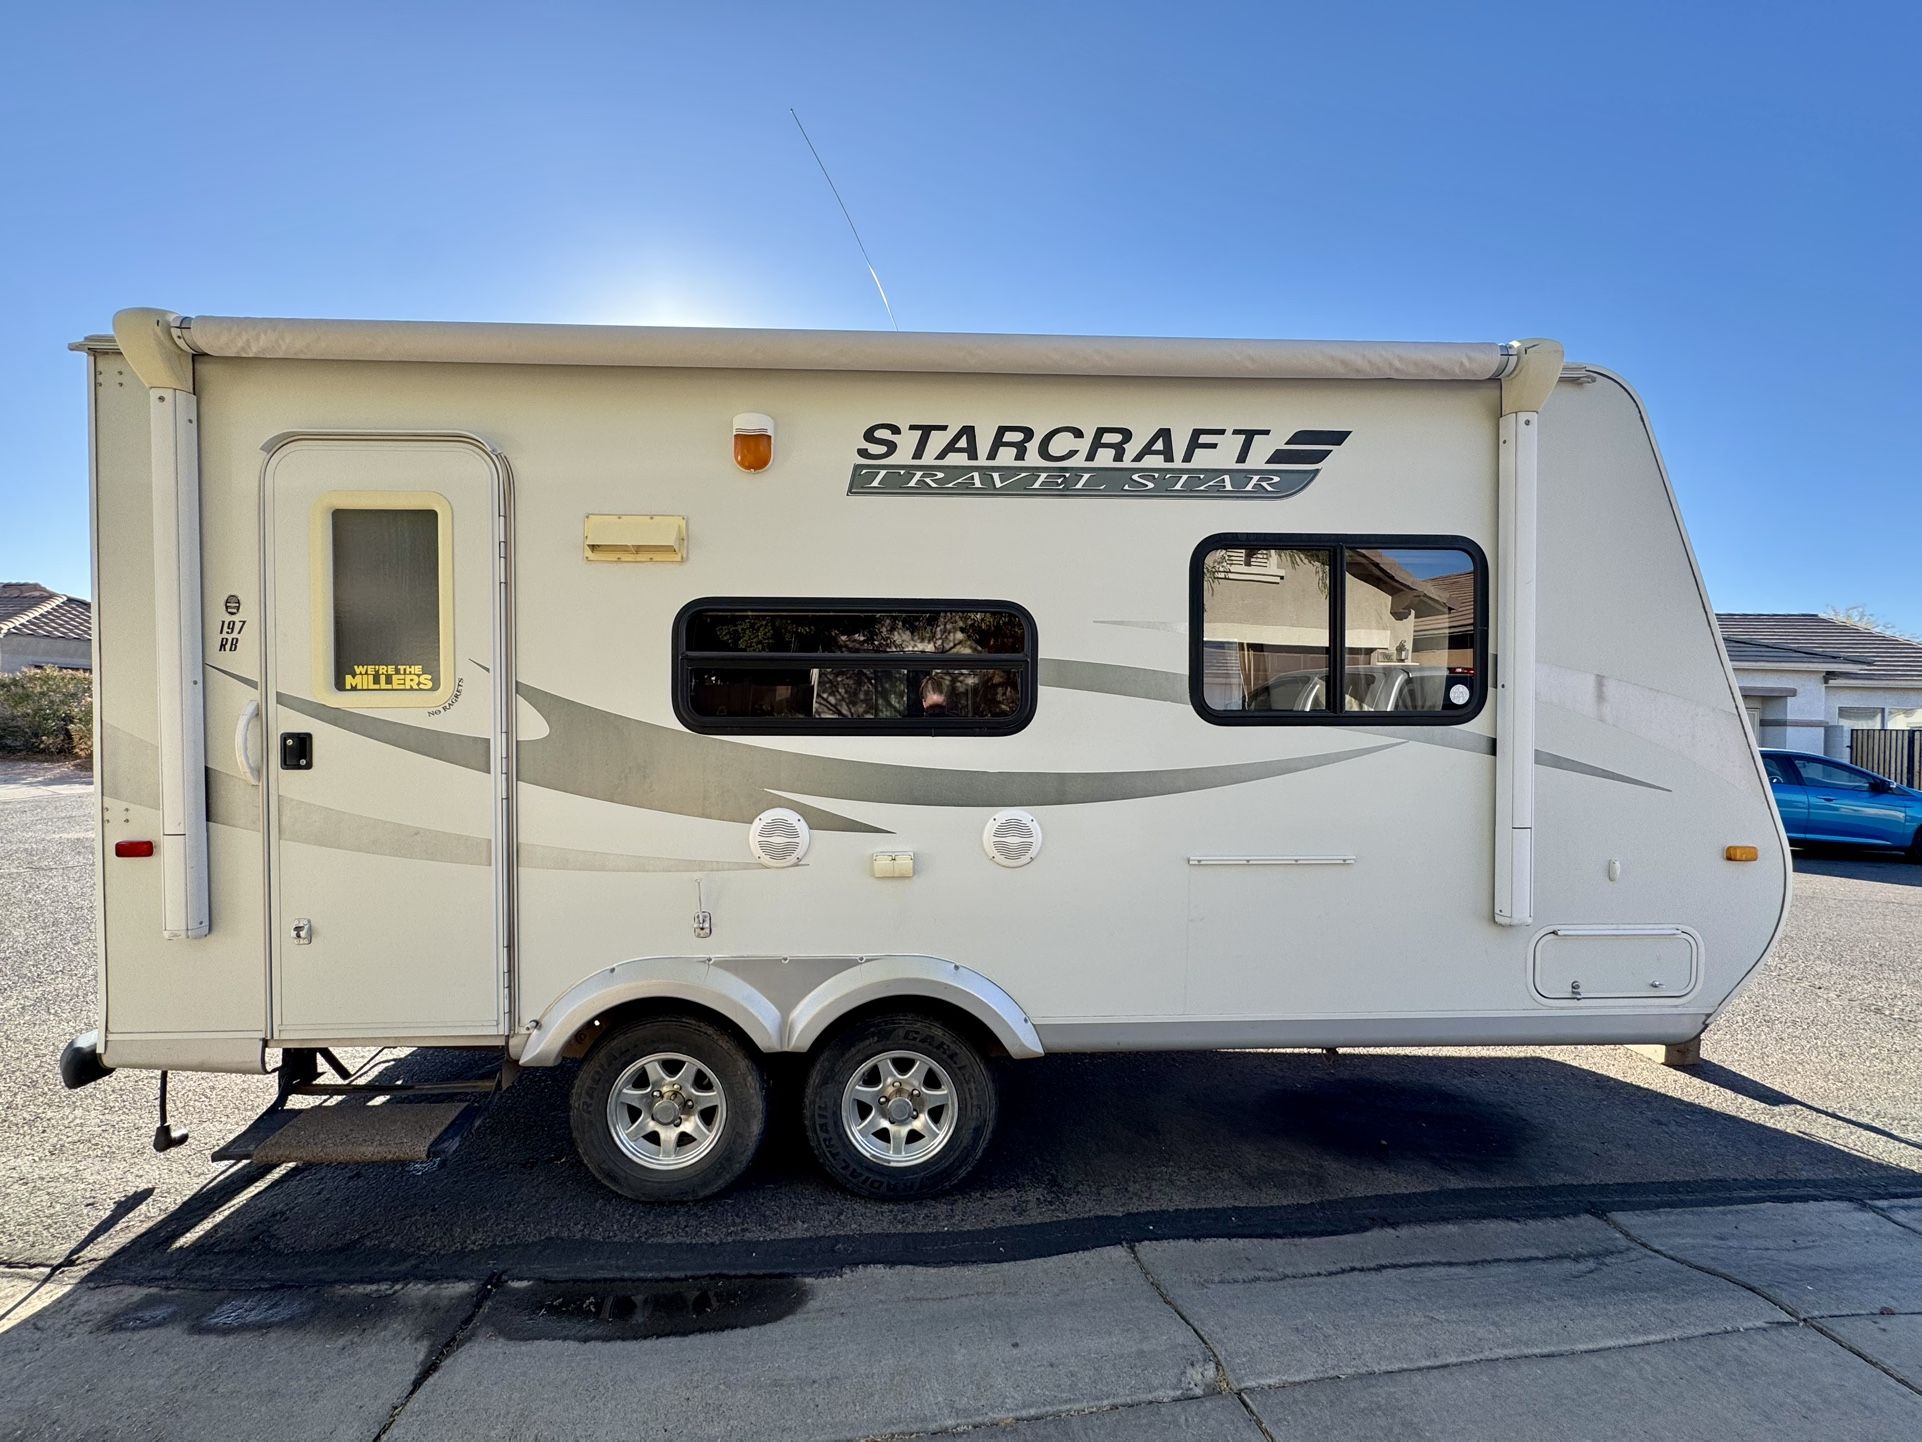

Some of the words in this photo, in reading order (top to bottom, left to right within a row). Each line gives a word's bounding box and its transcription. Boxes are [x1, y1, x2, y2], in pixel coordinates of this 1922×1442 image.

[856, 423, 1271, 463] STARCRAFT
[858, 469, 1106, 490] TRAVEL
[1123, 472, 1281, 491] STAR
[219, 620, 246, 635] 197
[218, 637, 239, 652] RB
[354, 665, 395, 674] WE'RE
[398, 665, 422, 674] THE
[345, 674, 433, 690] MILLERS
[442, 677, 464, 712] RAGRETS
